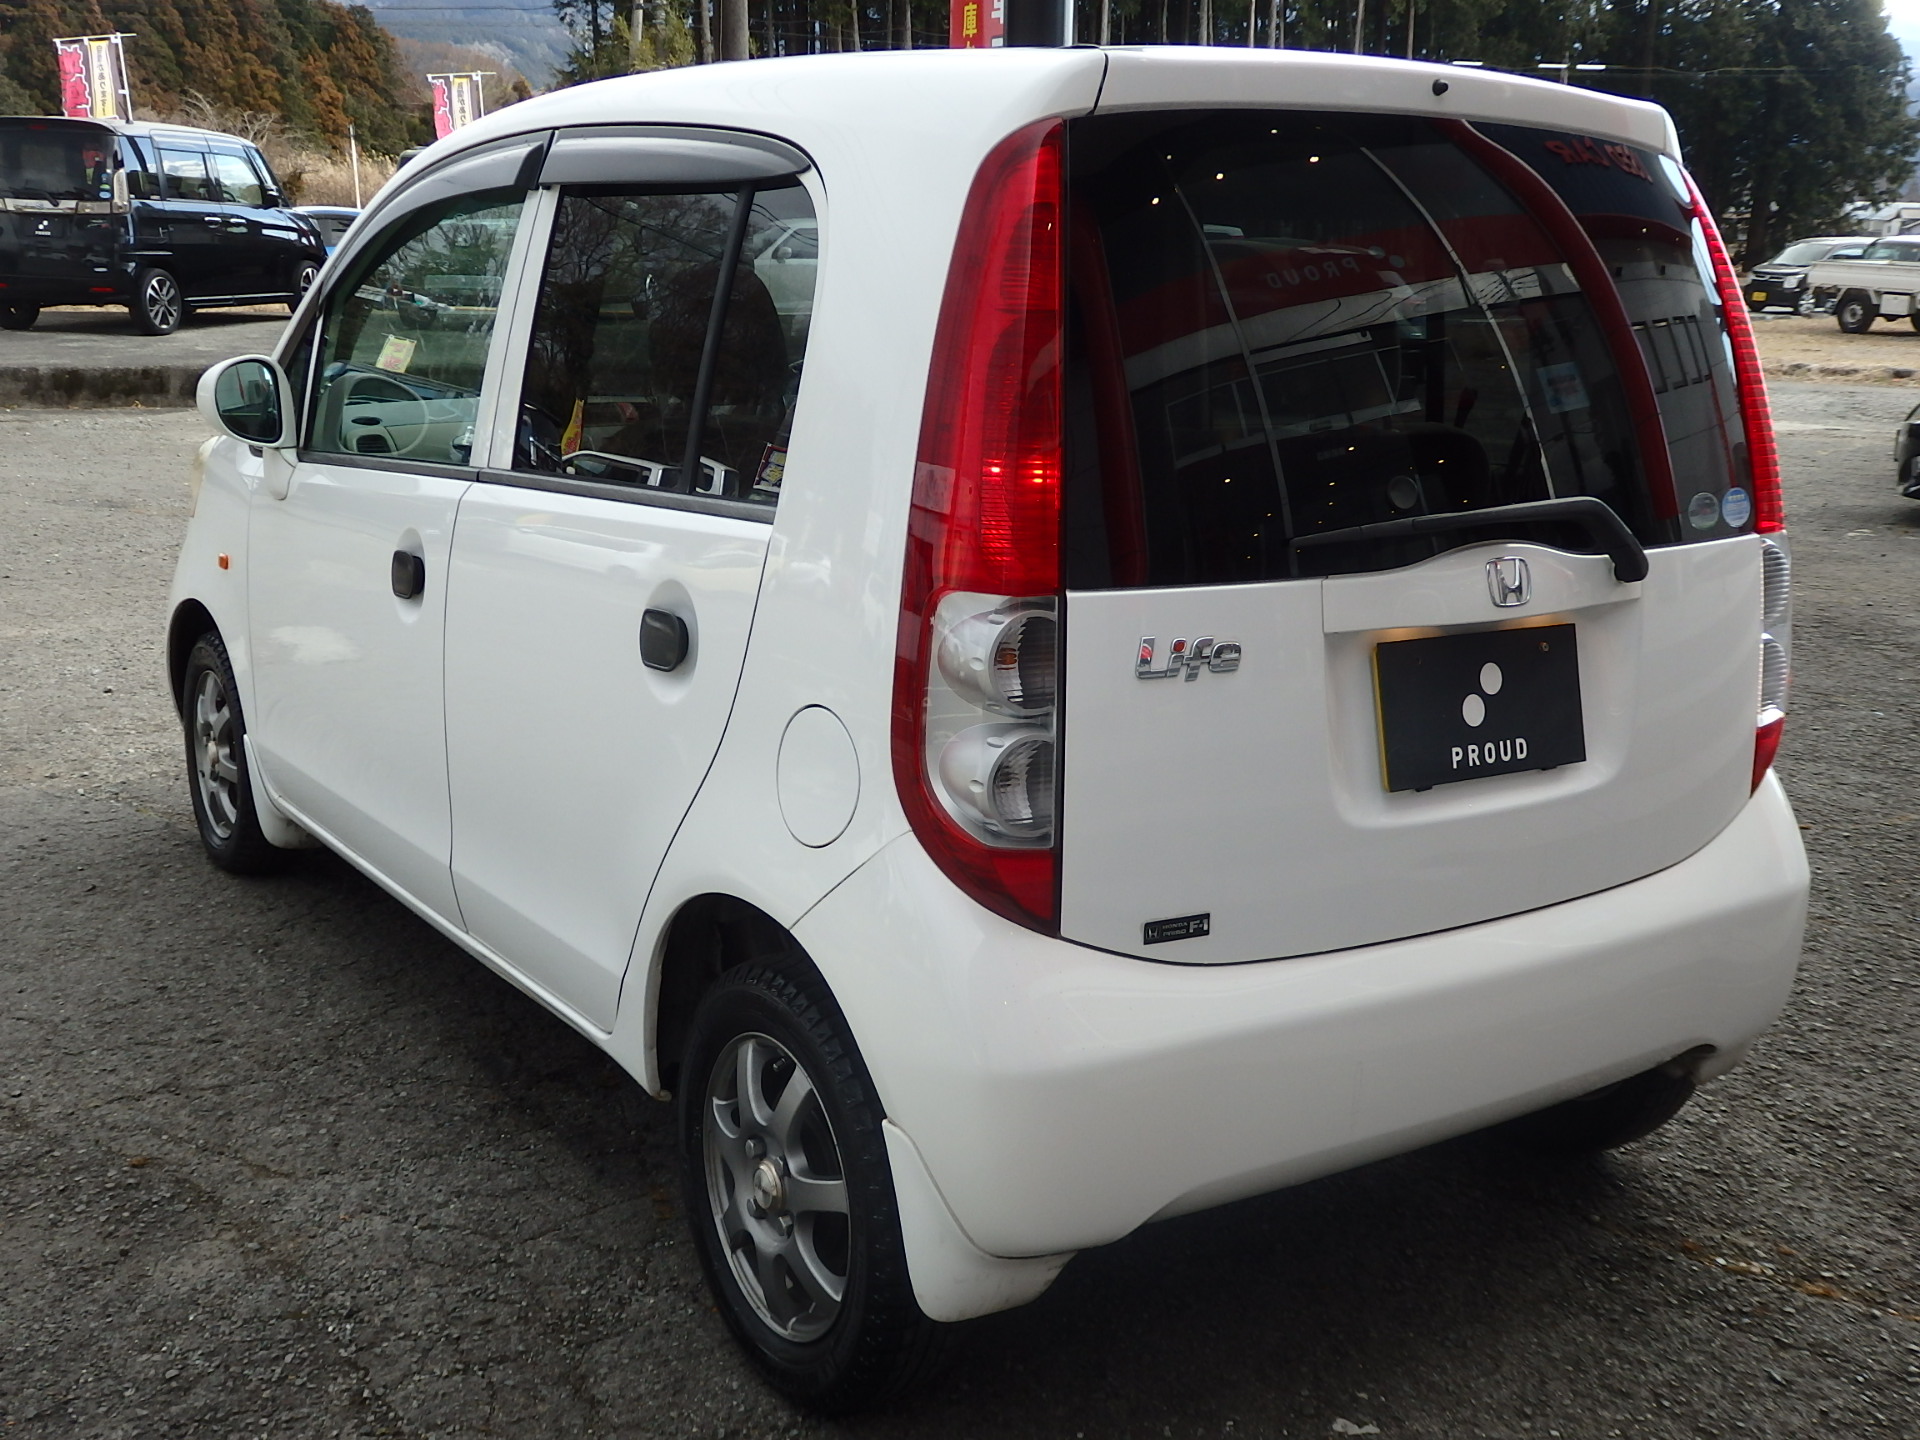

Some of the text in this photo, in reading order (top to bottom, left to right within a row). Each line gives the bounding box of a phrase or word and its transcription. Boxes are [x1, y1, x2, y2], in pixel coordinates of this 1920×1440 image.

[963, 1, 978, 48] 庫
[1135, 635, 1242, 682] Life
[1451, 737, 1528, 769] PROUD
[1189, 918, 1209, 933] F-1
